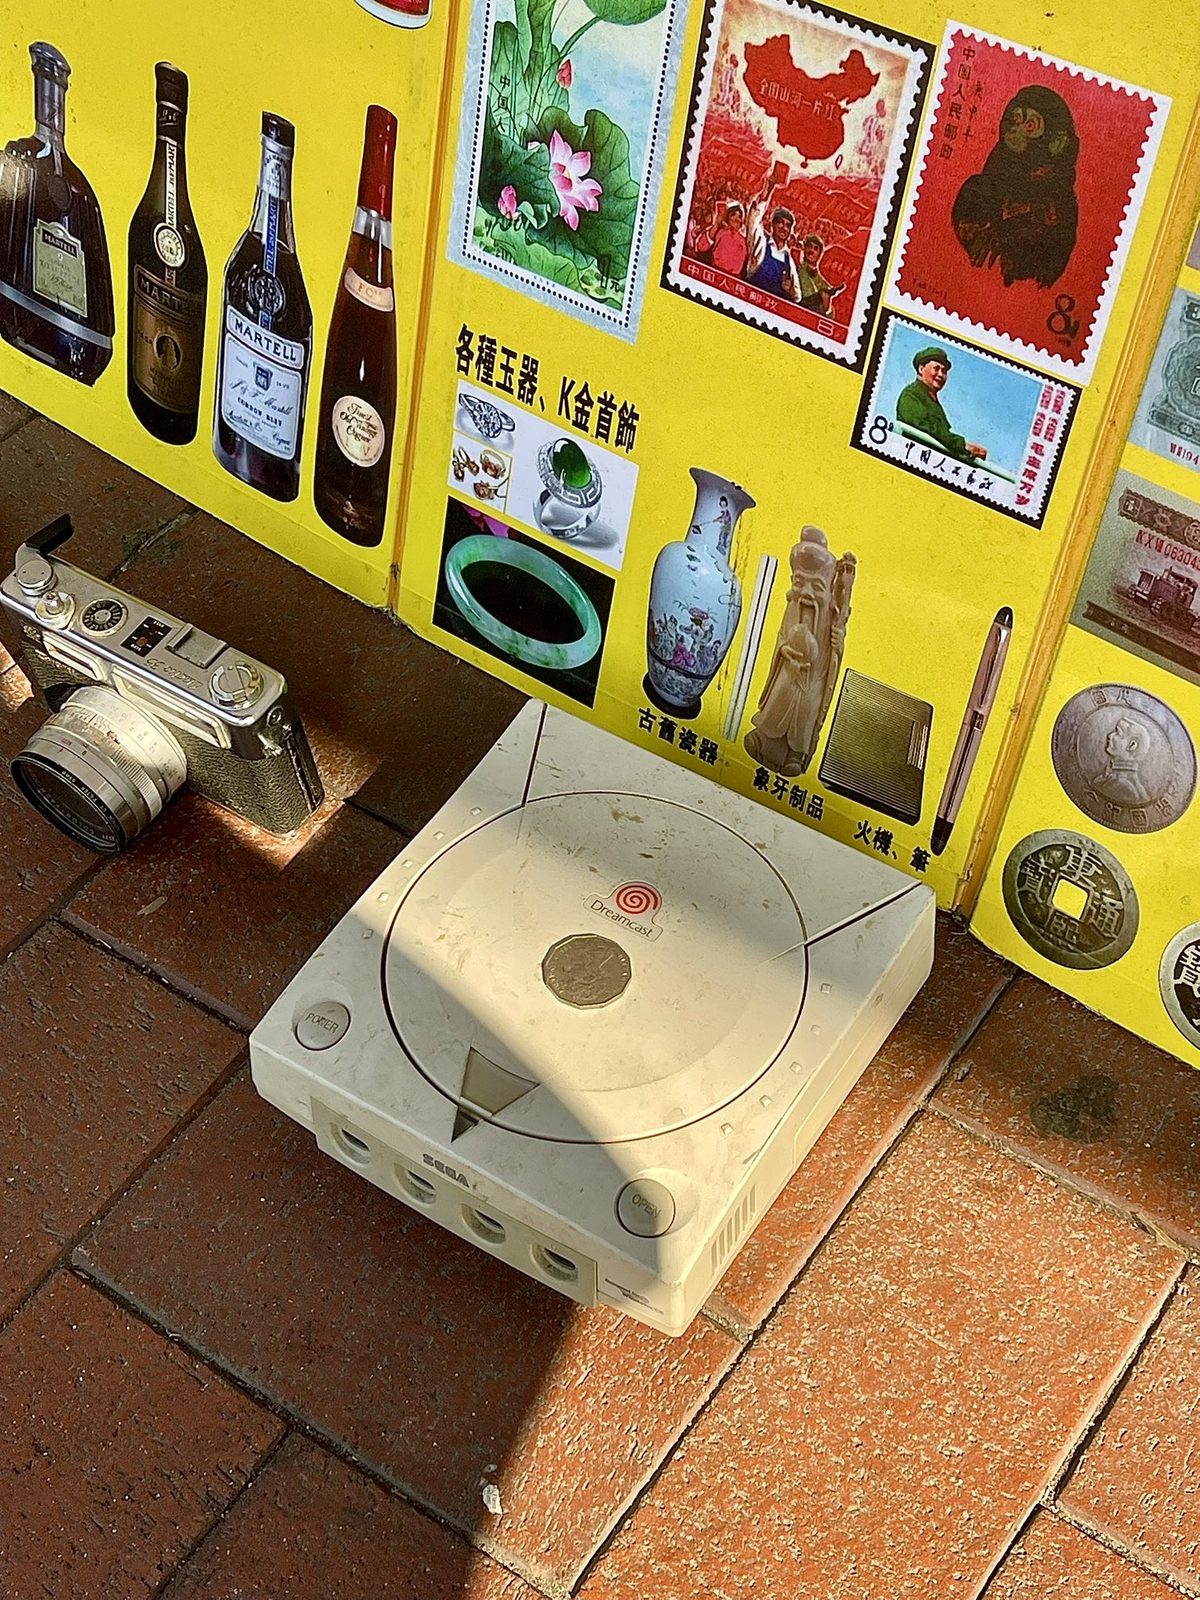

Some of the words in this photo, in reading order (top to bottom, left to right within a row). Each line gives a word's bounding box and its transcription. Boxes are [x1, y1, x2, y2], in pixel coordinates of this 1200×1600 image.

[44, 233, 76, 256] MARTELL
[234, 318, 297, 362] MARTELL
[637, 706, 720, 767] 古舊瓷器
[752, 766, 825, 822] 象牙制品
[853, 820, 932, 873] 火機、筆
[590, 899, 654, 938] Dreamcast
[305, 1012, 339, 1034] POWER
[422, 1153, 470, 1189] SEGA
[632, 1193, 662, 1219] OPEN
